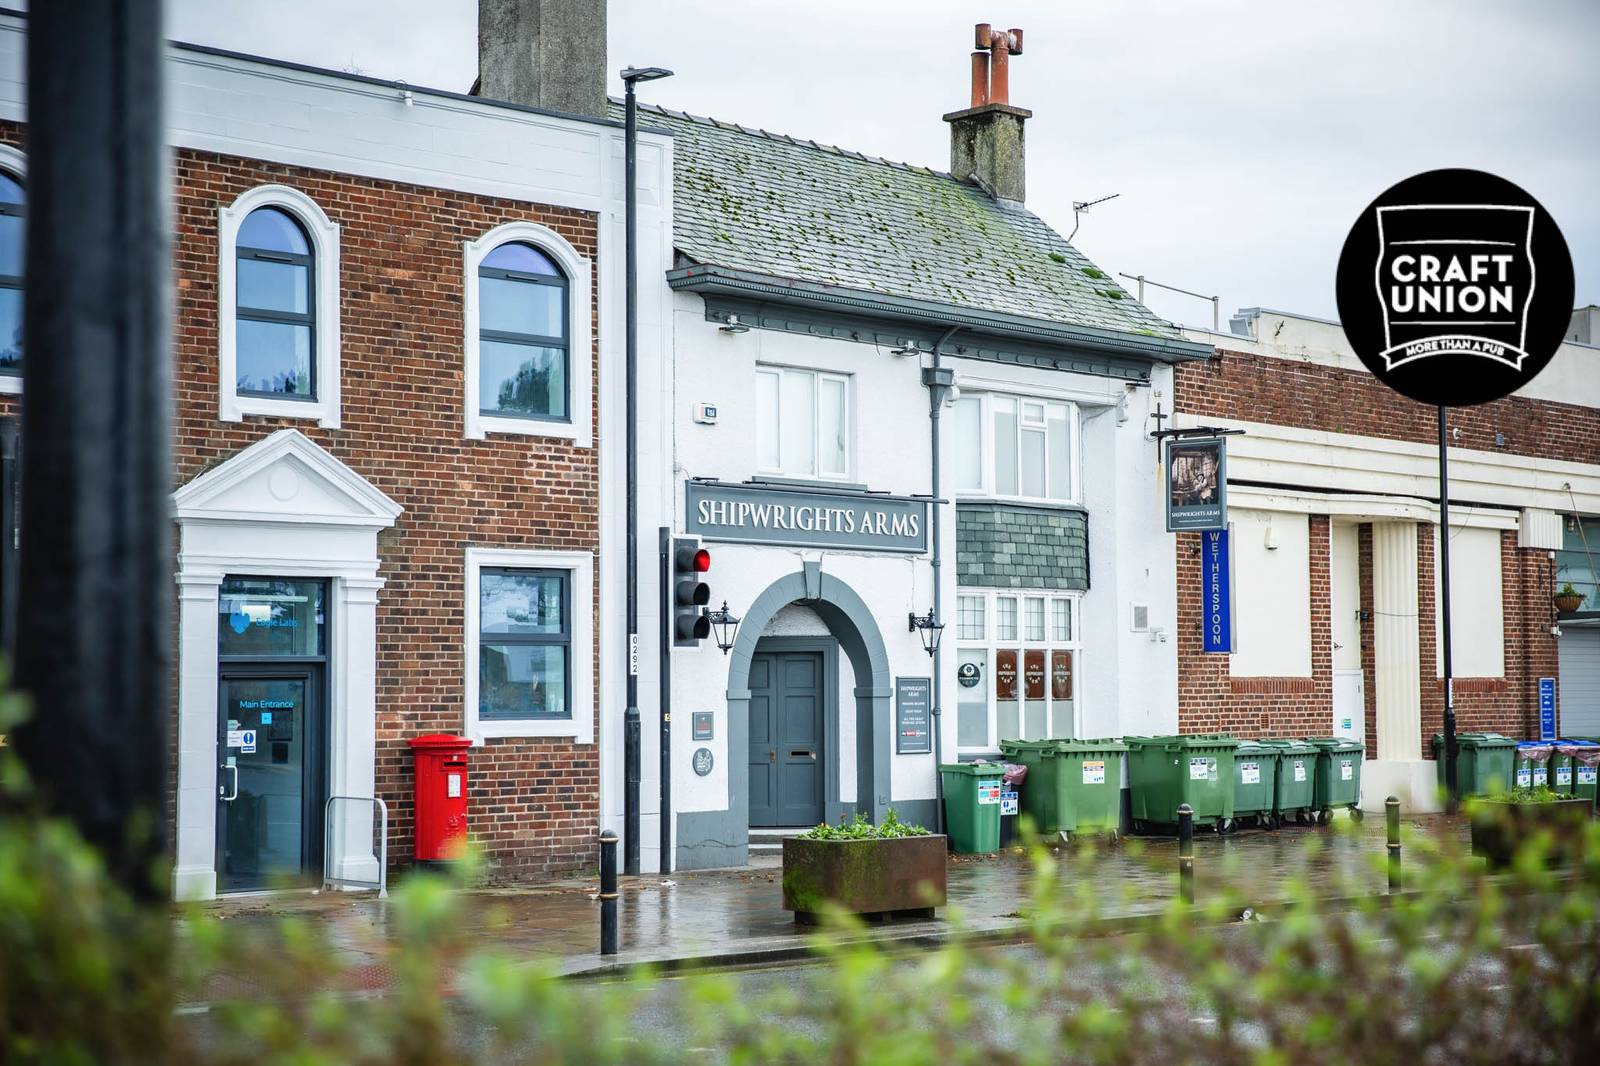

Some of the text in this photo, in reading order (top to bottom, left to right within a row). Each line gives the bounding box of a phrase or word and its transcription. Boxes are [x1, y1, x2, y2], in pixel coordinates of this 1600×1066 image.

[698, 500, 919, 538] SHIPWRIGHTS ARMS
[1171, 510, 1205, 518] SHIPWRIGHTS
[1209, 532, 1221, 645] WETHERSPOON
[239, 700, 294, 709] Main Entrance
